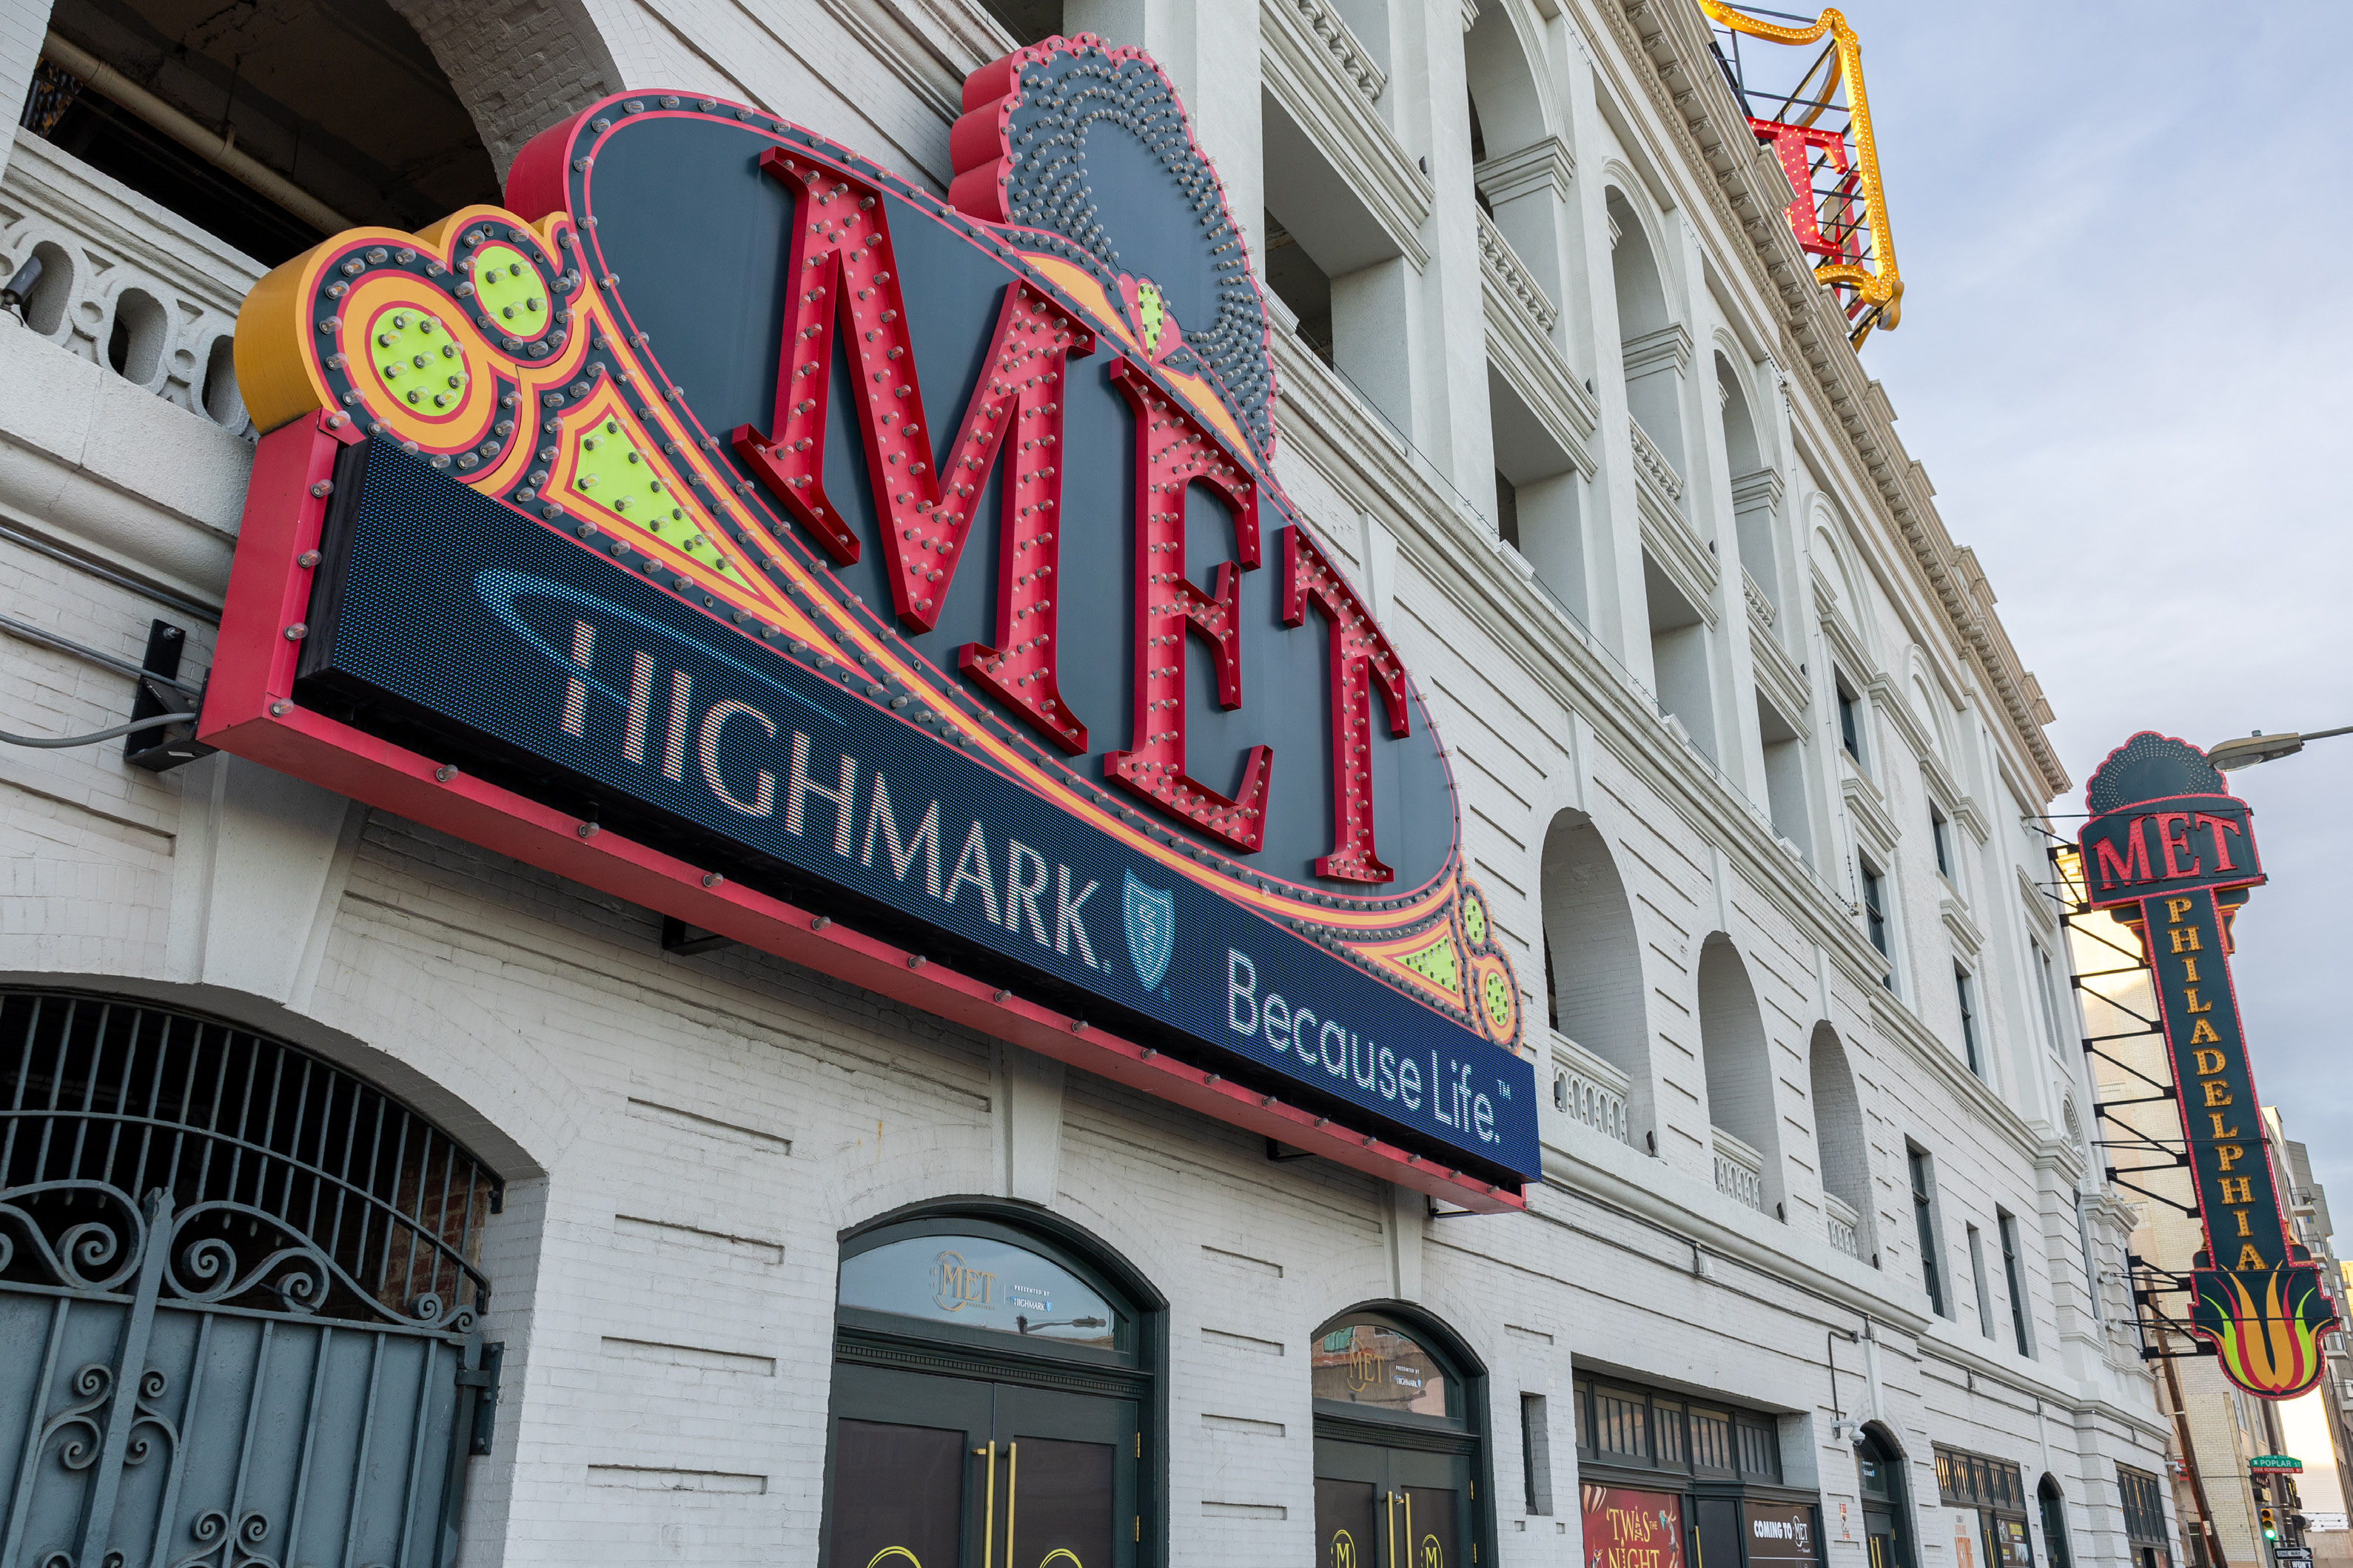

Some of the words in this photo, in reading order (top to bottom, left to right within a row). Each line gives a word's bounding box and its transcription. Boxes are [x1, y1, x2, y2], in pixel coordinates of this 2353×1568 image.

[732, 147, 1409, 884] MET
[2091, 811, 2241, 892] MET
[1227, 947, 1422, 1111] Because
[2164, 897, 2269, 1271] PHILADELPHIA
[941, 1263, 996, 1304] MET
[1014, 1285, 1042, 1295] PRESENTED
[1349, 1350, 1385, 1383] MET
[1395, 1365, 1414, 1373] PRESENTED
[2260, 1459, 2292, 1467] POPLAR
[1649, 1521, 1658, 1530] THE
[1753, 1520, 1783, 1539] COMING
[1783, 1522, 1793, 1540] TO
[1794, 1523, 1807, 1541] MET
[1608, 1545, 1660, 1568] NIGHT
